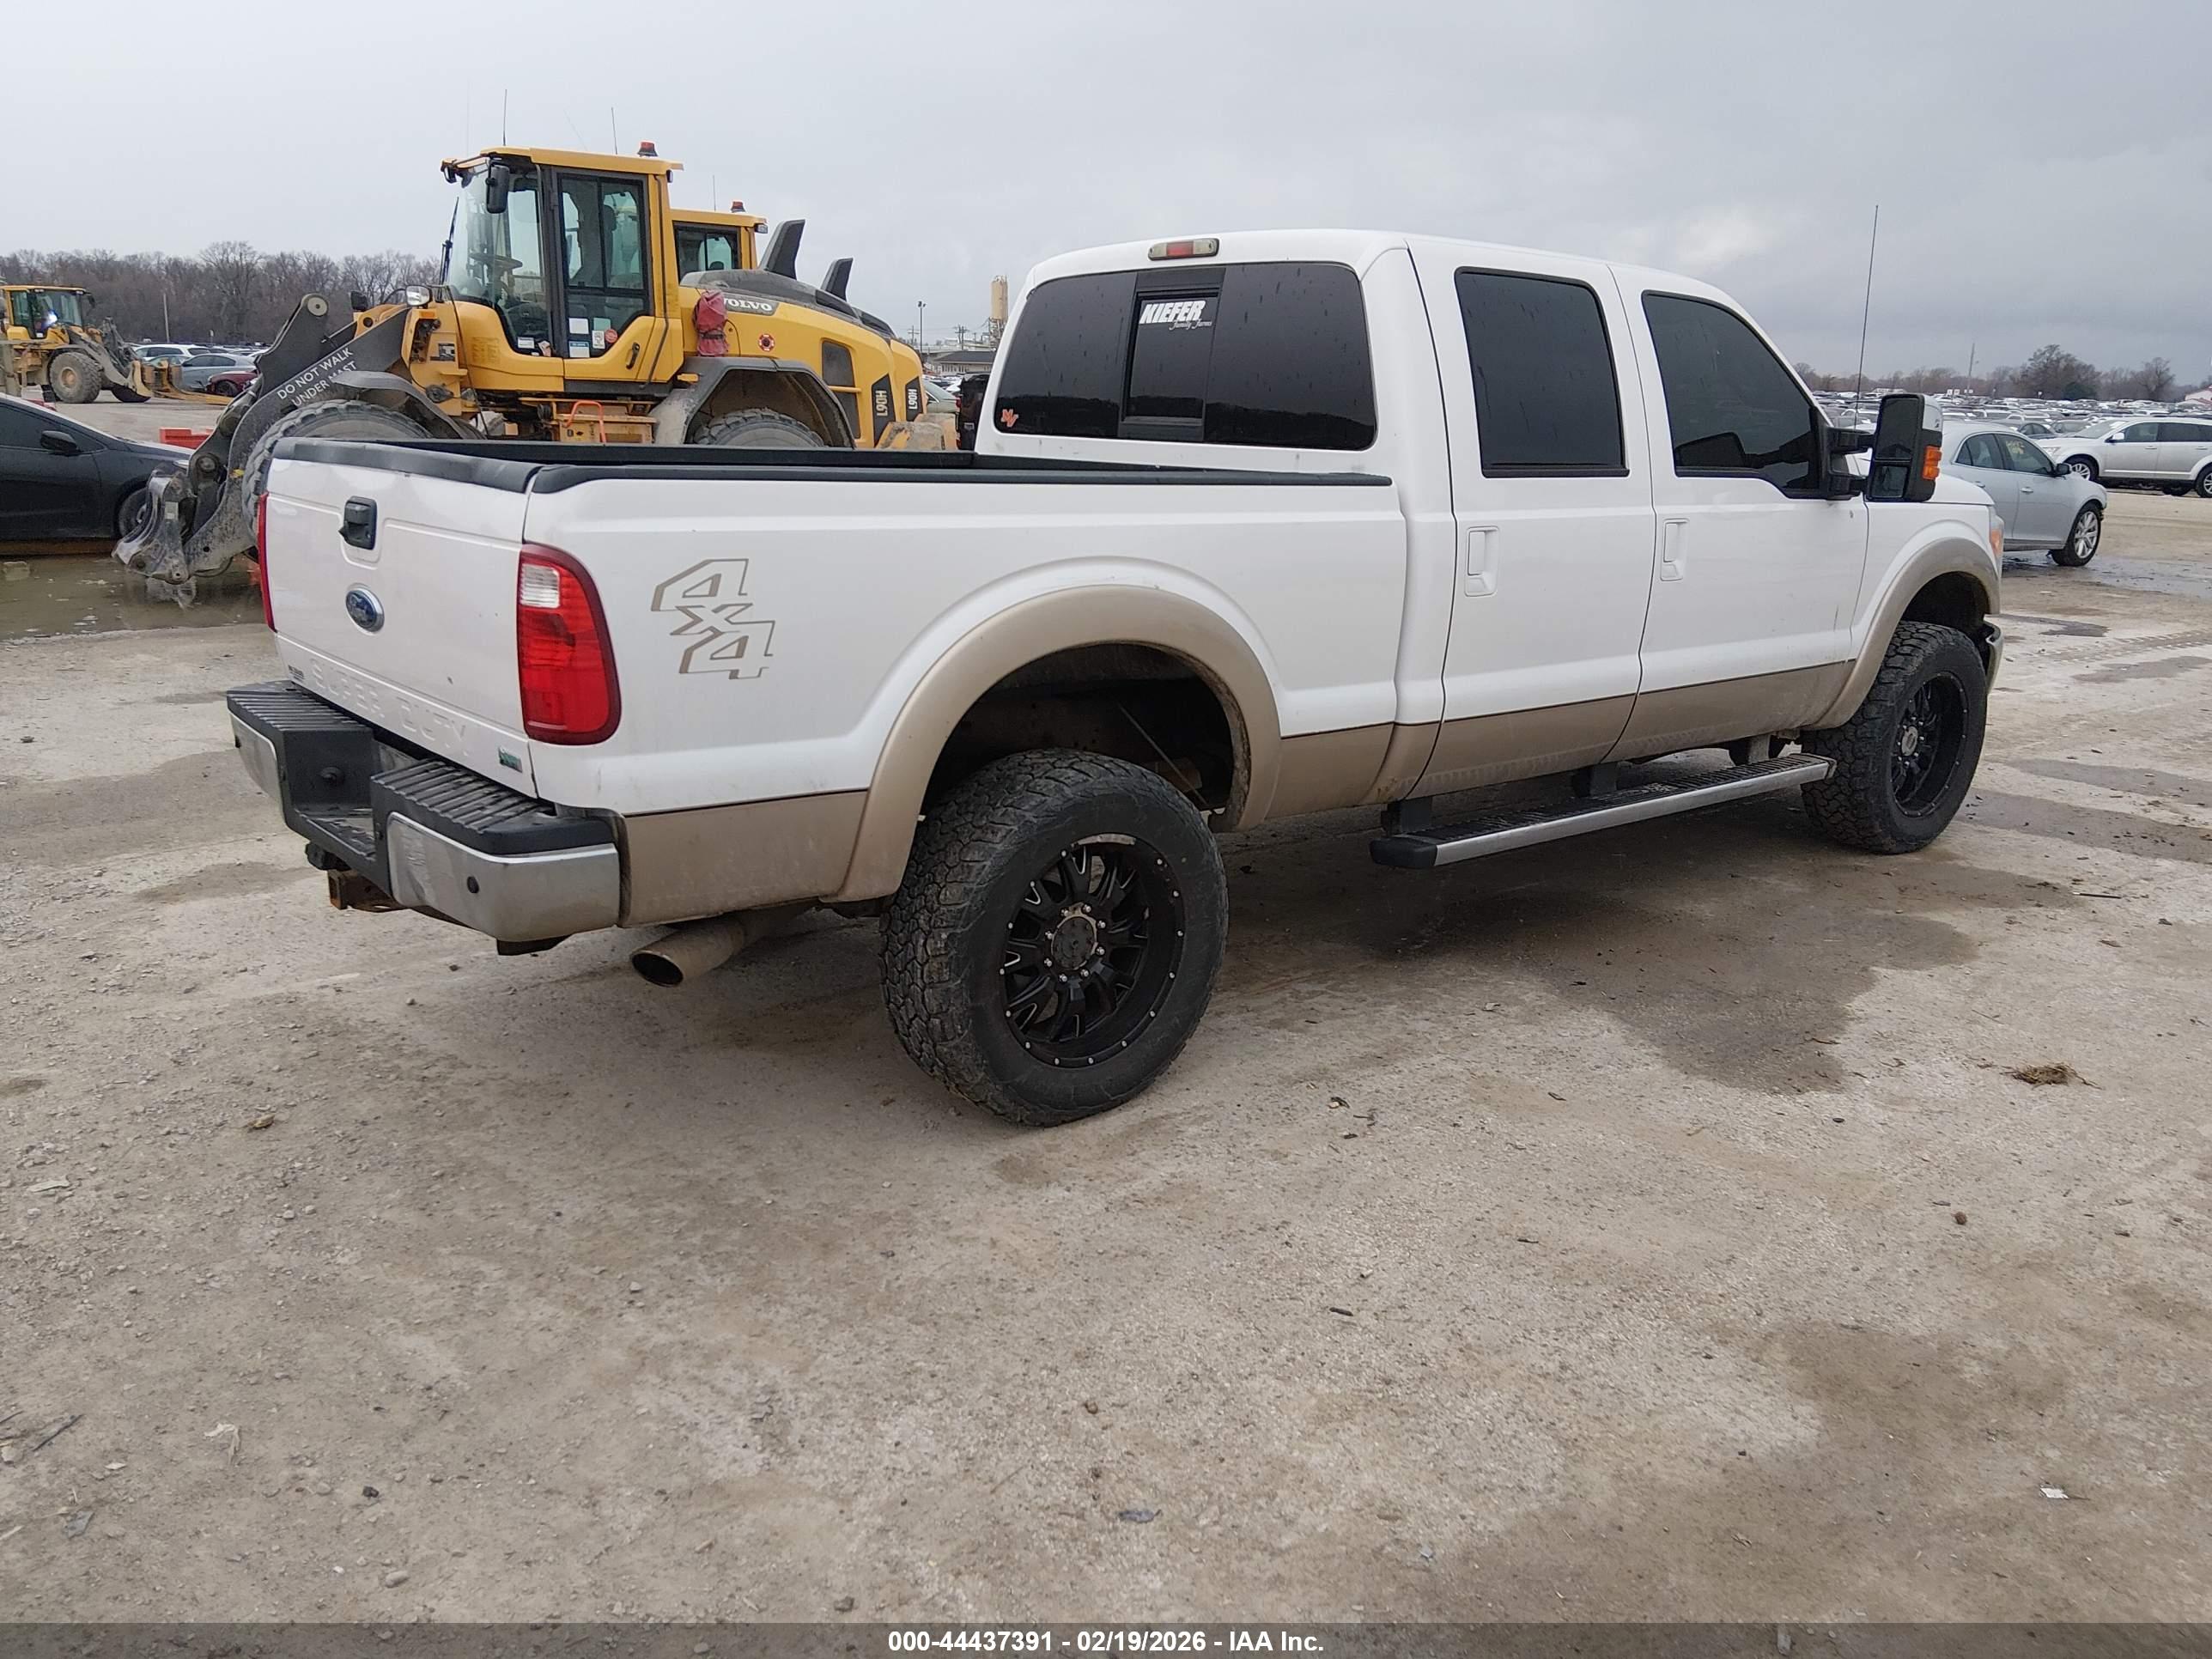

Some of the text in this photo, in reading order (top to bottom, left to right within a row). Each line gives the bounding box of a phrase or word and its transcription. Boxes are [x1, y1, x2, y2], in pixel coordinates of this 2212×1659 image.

[1139, 300, 1206, 325] KIEFER
[276, 347, 354, 400] DO NOT WALK
[290, 380, 331, 407] UNDER
[875, 390, 889, 416] L90H
[908, 388, 918, 410] L90H
